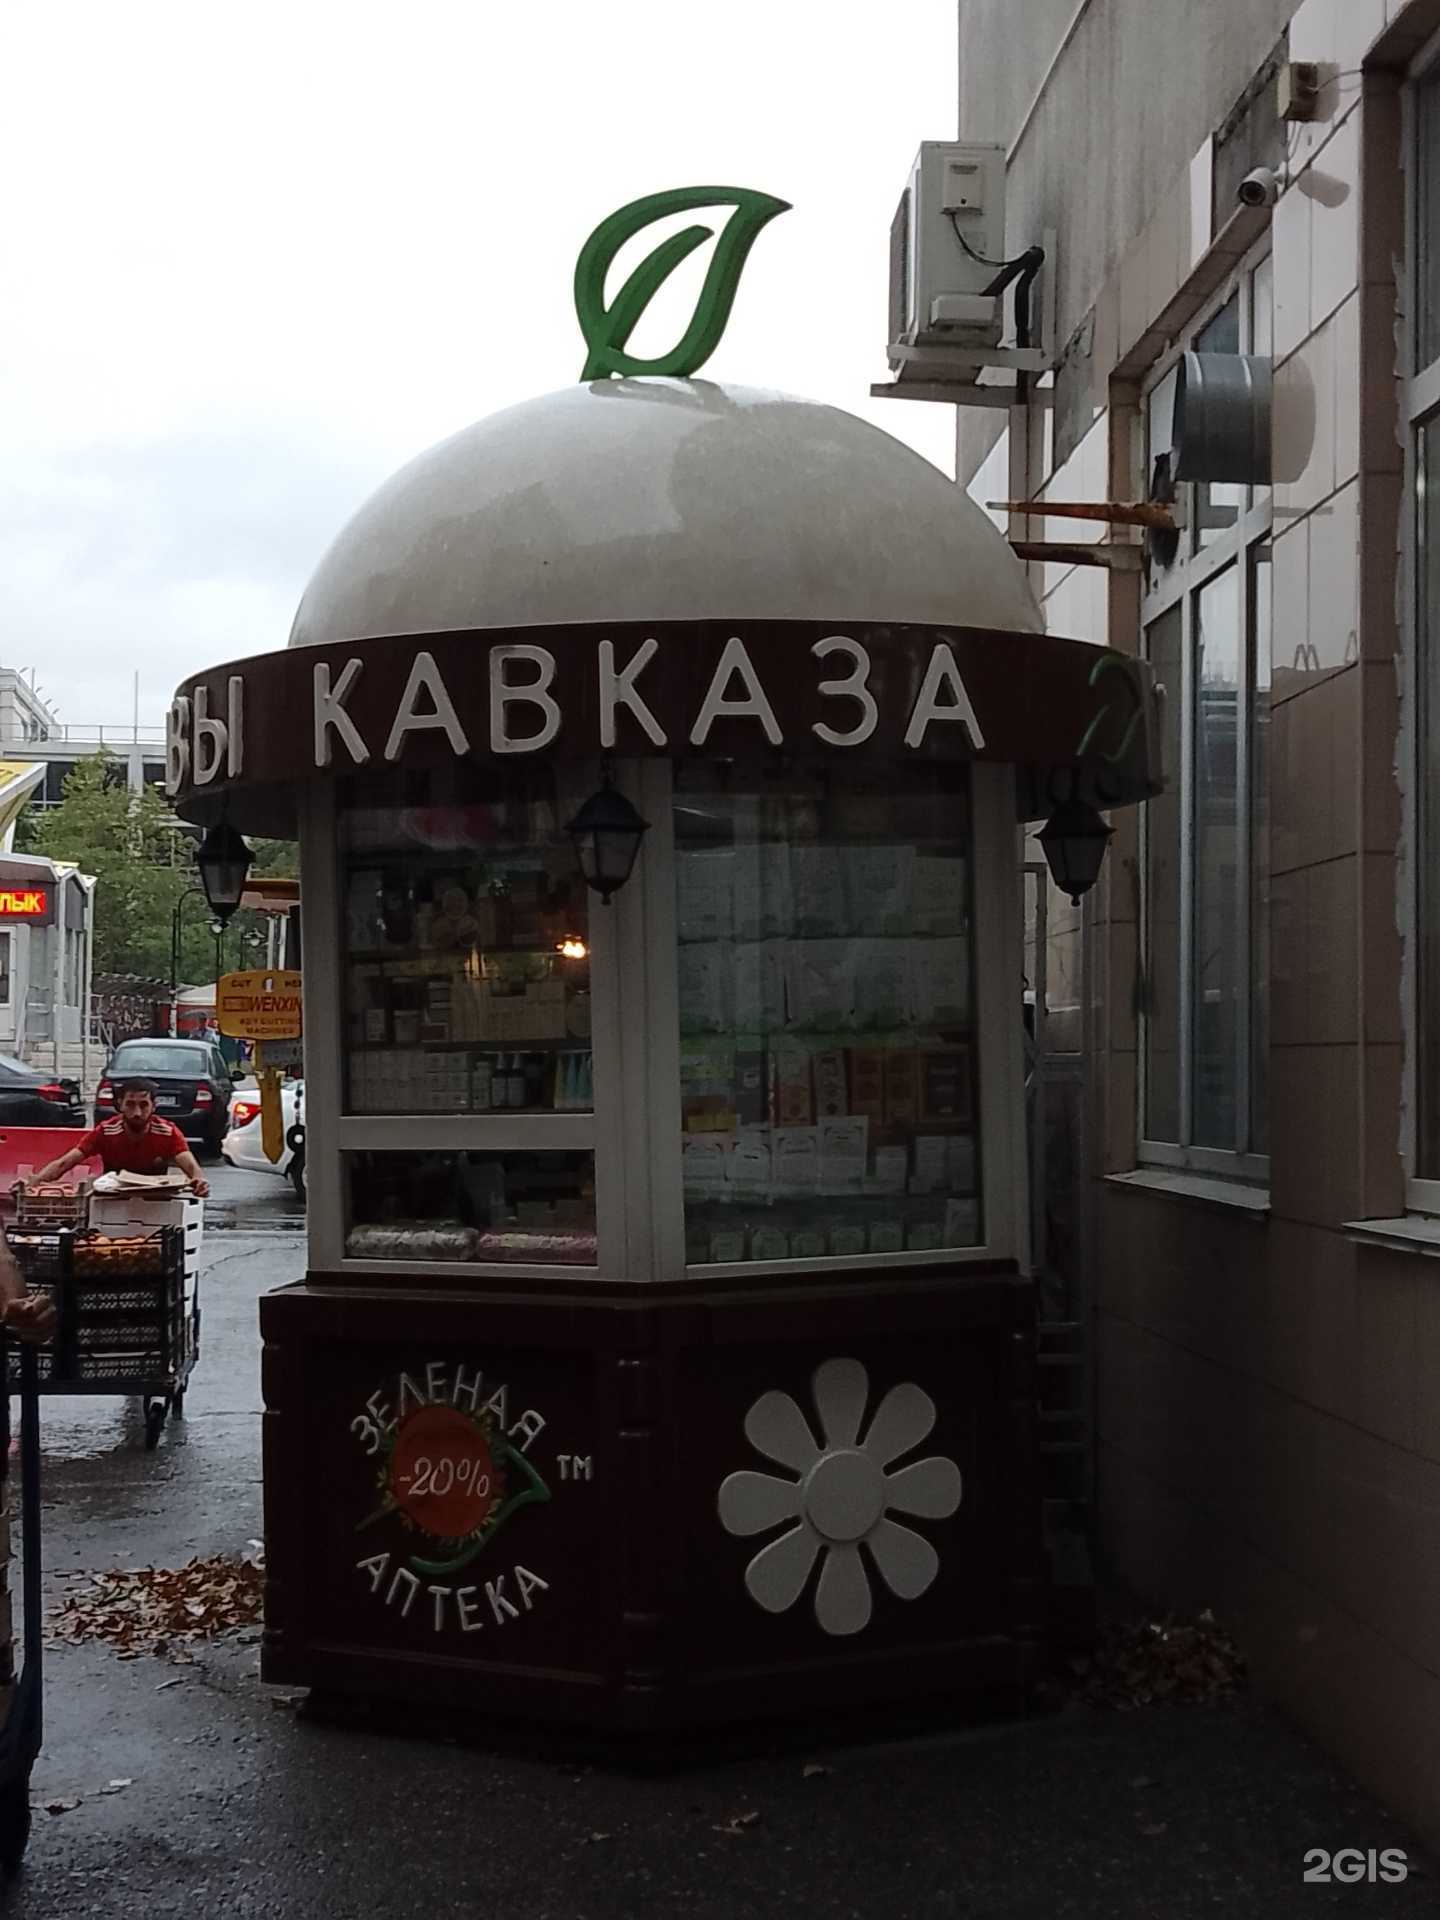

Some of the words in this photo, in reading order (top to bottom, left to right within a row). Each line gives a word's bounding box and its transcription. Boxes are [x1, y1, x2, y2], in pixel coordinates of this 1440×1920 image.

[165, 676, 243, 796] ВЫ
[313, 635, 986, 767] КАВКАЗА
[351, 1361, 546, 1455] ЗЕЛЕНАЯ
[399, 1457, 489, 1497] -20%
[356, 1552, 549, 1632] АПТЕКА
